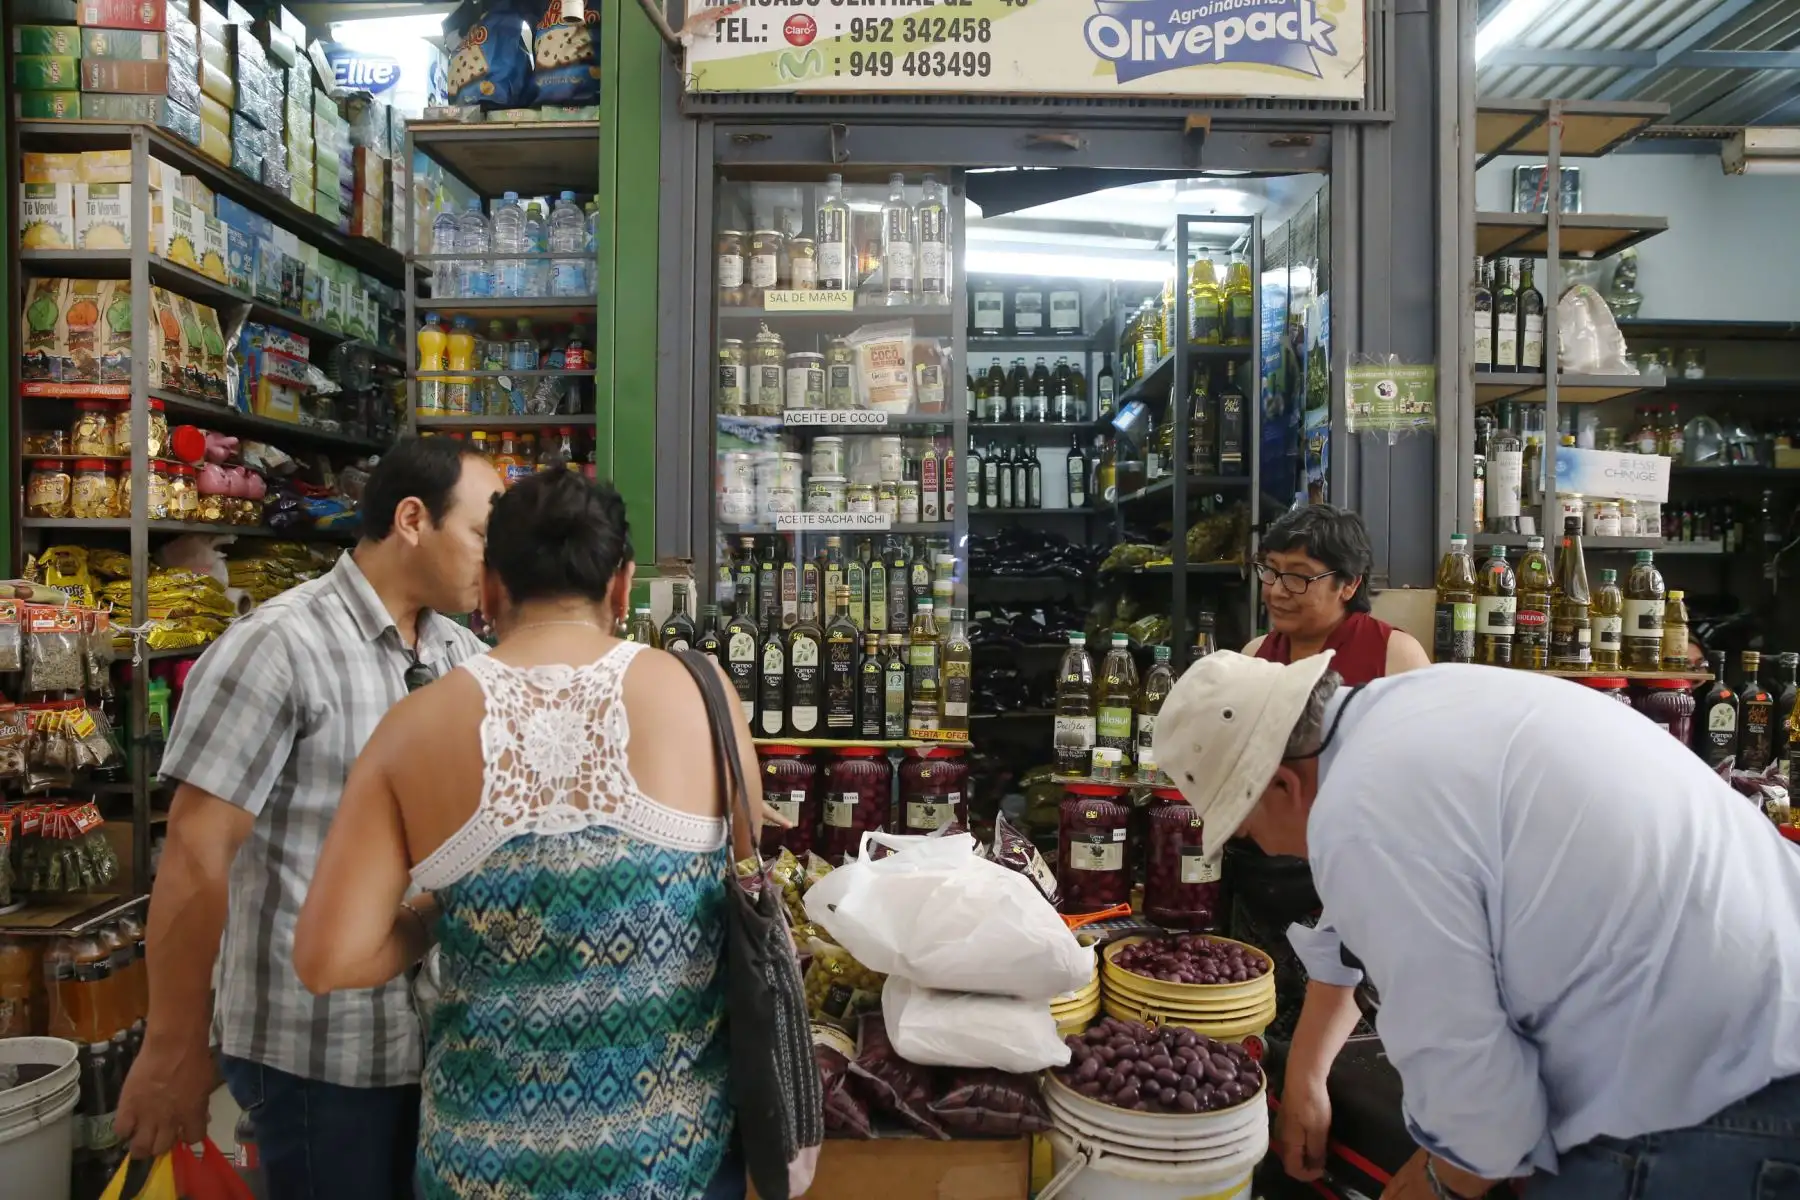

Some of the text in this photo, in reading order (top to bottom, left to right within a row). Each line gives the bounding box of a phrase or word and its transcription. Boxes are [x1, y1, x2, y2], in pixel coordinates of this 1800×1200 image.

[785, 25, 812, 35] Claro
[849, 17, 894, 43] 952
[902, 17, 992, 43] 342458
[1088, 1, 1337, 61] Olivepack
[849, 51, 894, 77] 949
[902, 51, 992, 77] 483499
[333, 59, 395, 85] Elite
[34, 201, 58, 216] Verde
[769, 292, 847, 303] SAL DE MARAS
[785, 413, 886, 424] ACEITE DE COCO
[1604, 468, 1657, 482] CHANGE
[777, 514, 885, 525] ACEITE SACHA INCHI
